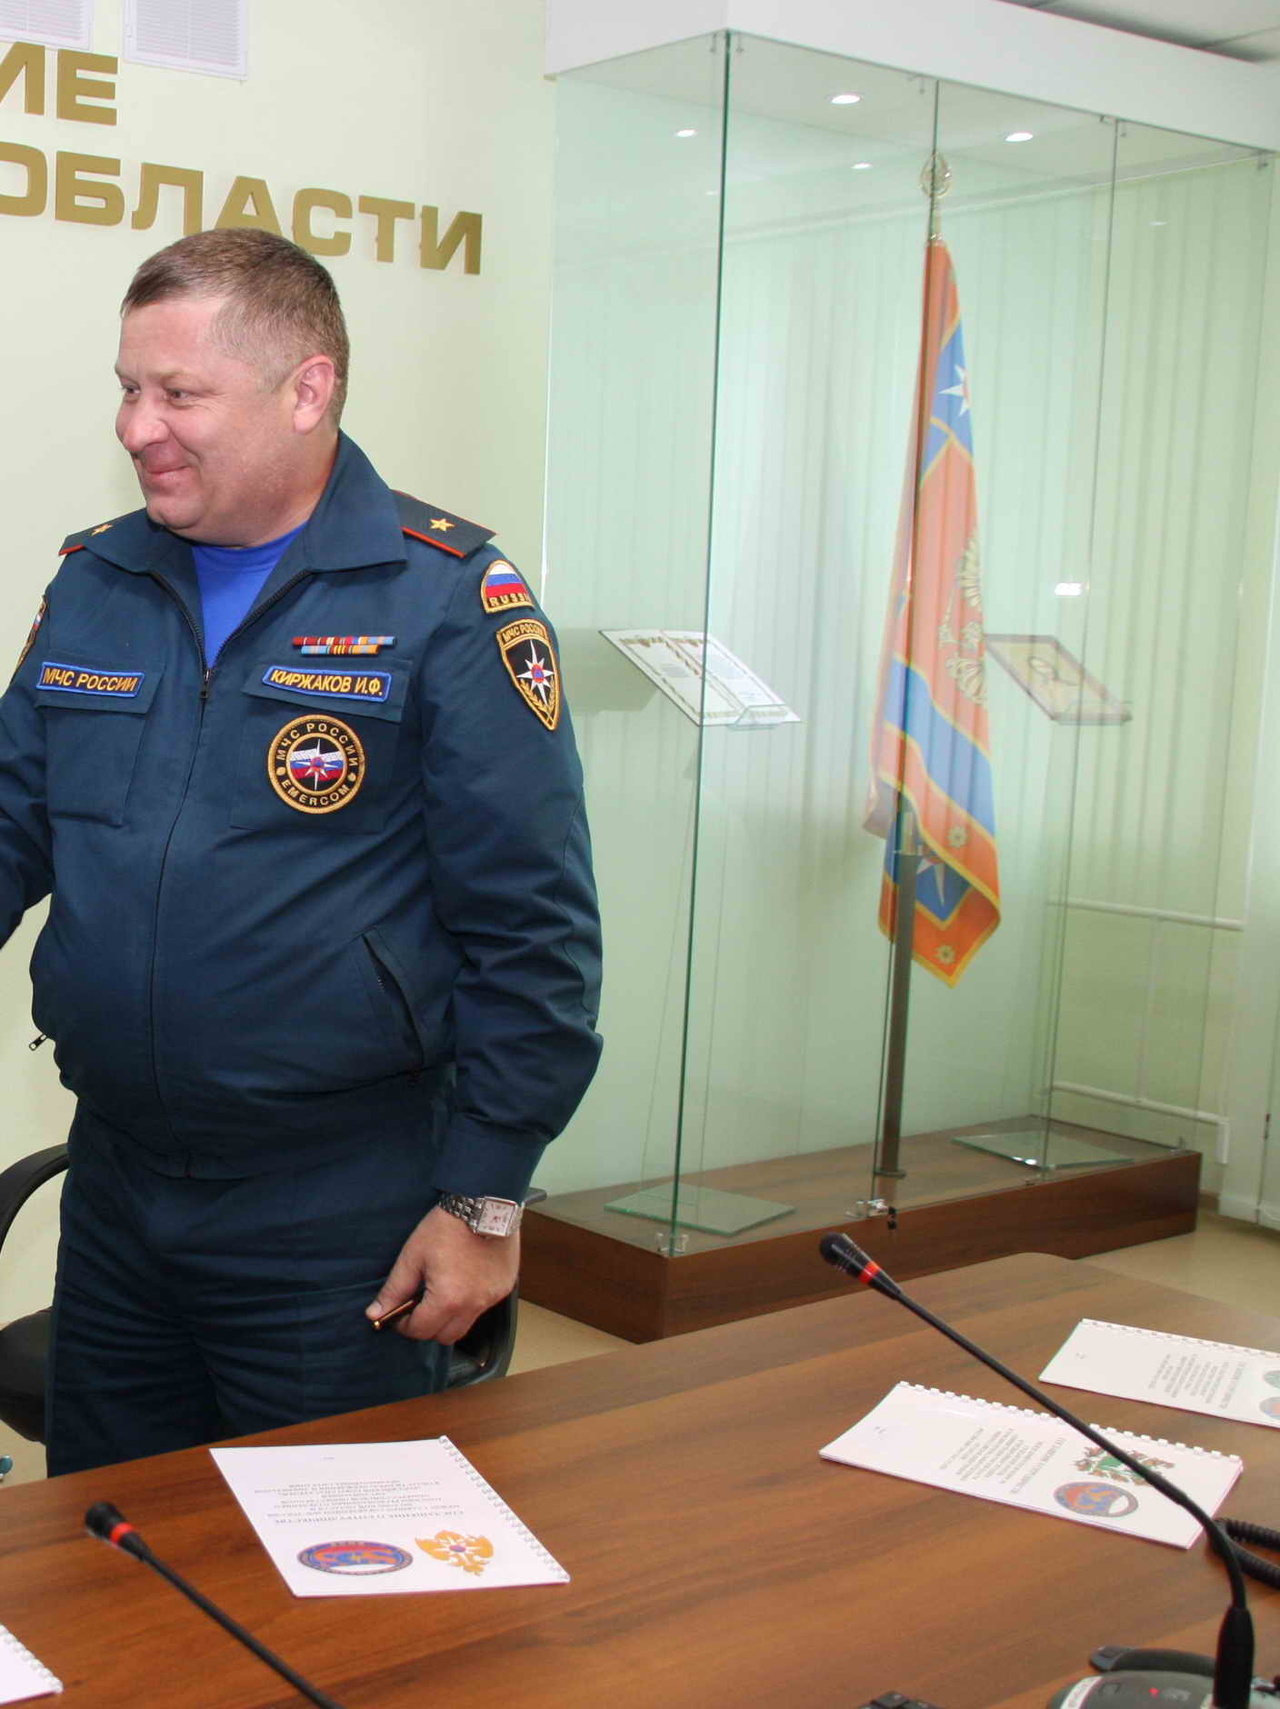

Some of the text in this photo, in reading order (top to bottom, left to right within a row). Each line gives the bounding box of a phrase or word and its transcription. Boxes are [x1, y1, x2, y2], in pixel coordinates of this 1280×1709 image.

[42, 667, 138, 691] МЧС РОССИИ
[270, 670, 382, 695] КИРЖАКОВ И.Ф.
[276, 723, 359, 767] МЧС РОССИИ
[281, 779, 350, 806] EMERCOM
